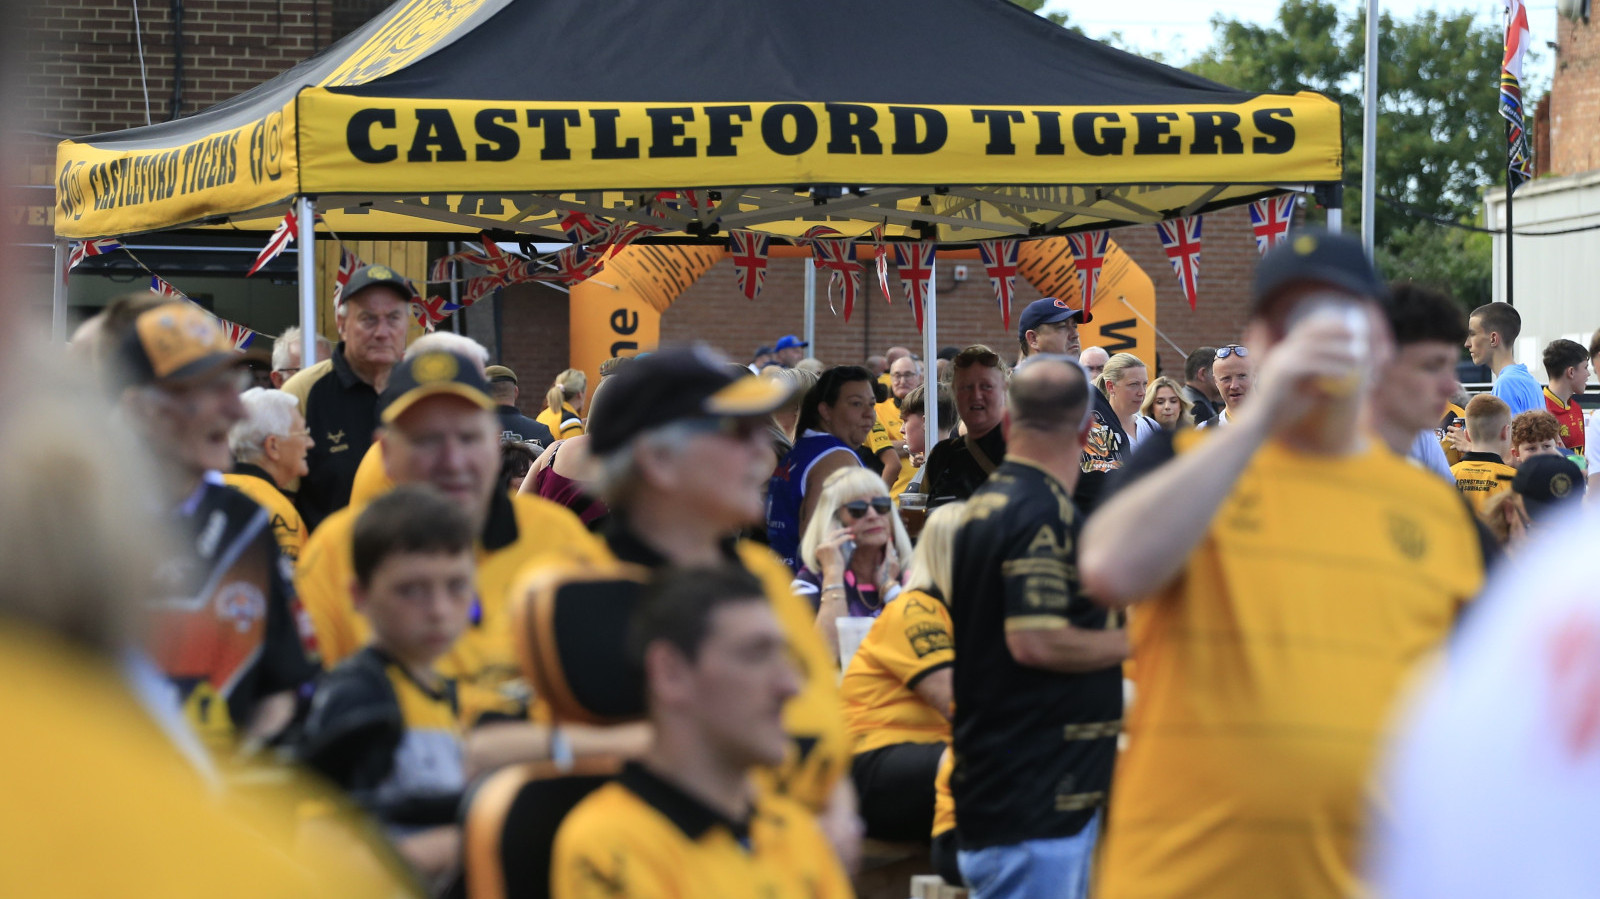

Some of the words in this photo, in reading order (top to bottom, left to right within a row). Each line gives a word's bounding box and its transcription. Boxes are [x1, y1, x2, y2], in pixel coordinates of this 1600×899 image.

[346, 103, 948, 164] CASTLEFORD
[971, 107, 1296, 156] TIGERS
[89, 150, 180, 211] CASTLEFORD
[181, 130, 241, 195] TIGERS
